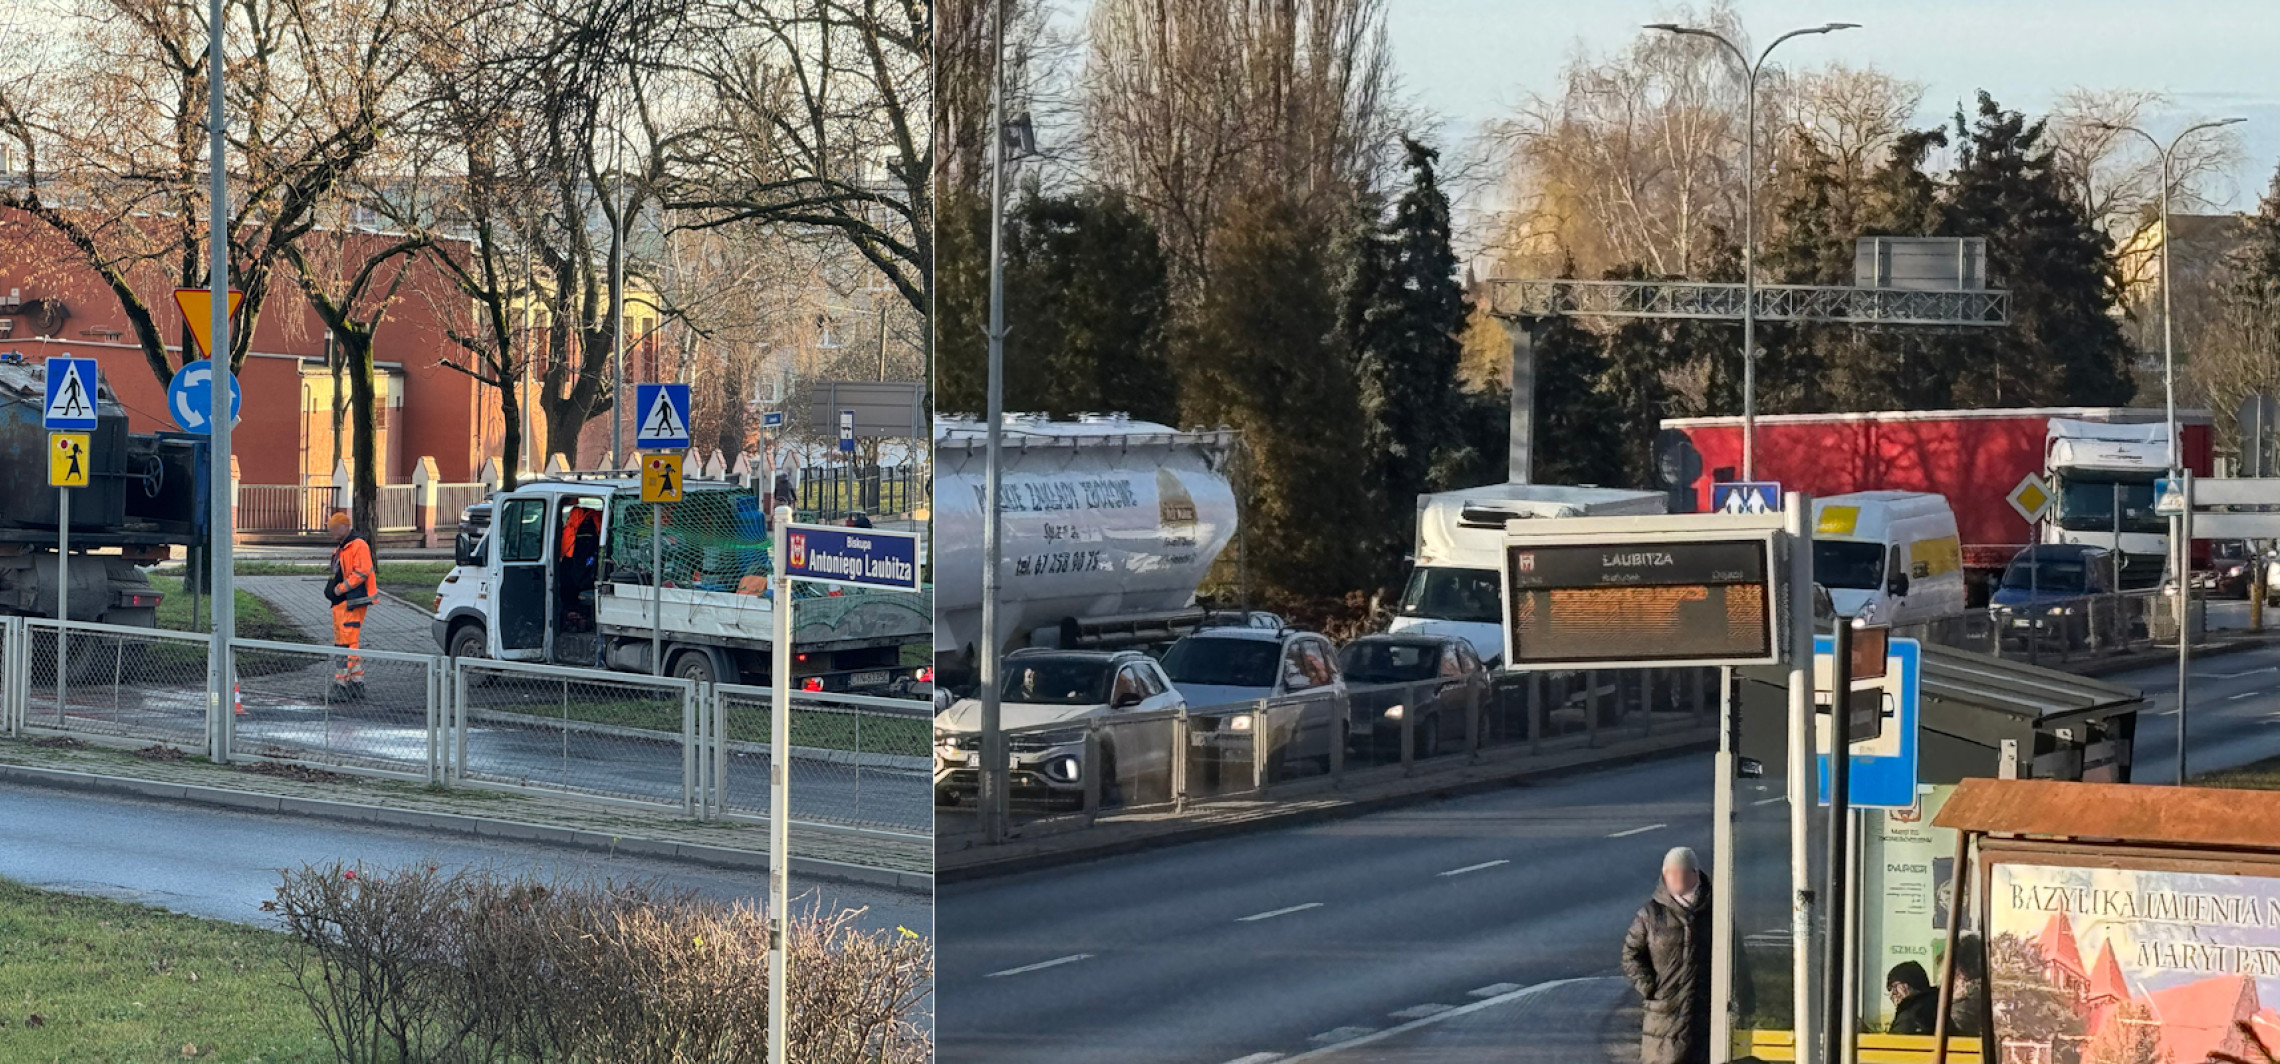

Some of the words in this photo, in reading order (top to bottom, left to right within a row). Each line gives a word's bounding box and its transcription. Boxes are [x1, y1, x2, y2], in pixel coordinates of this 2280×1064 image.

[846, 535, 872, 551] Biskupa
[808, 548, 862, 580] Antoniego
[865, 553, 912, 581] Laubitza
[2010, 884, 2137, 917] BAZYLIKA
[2144, 891, 2261, 926] IMIENIA
